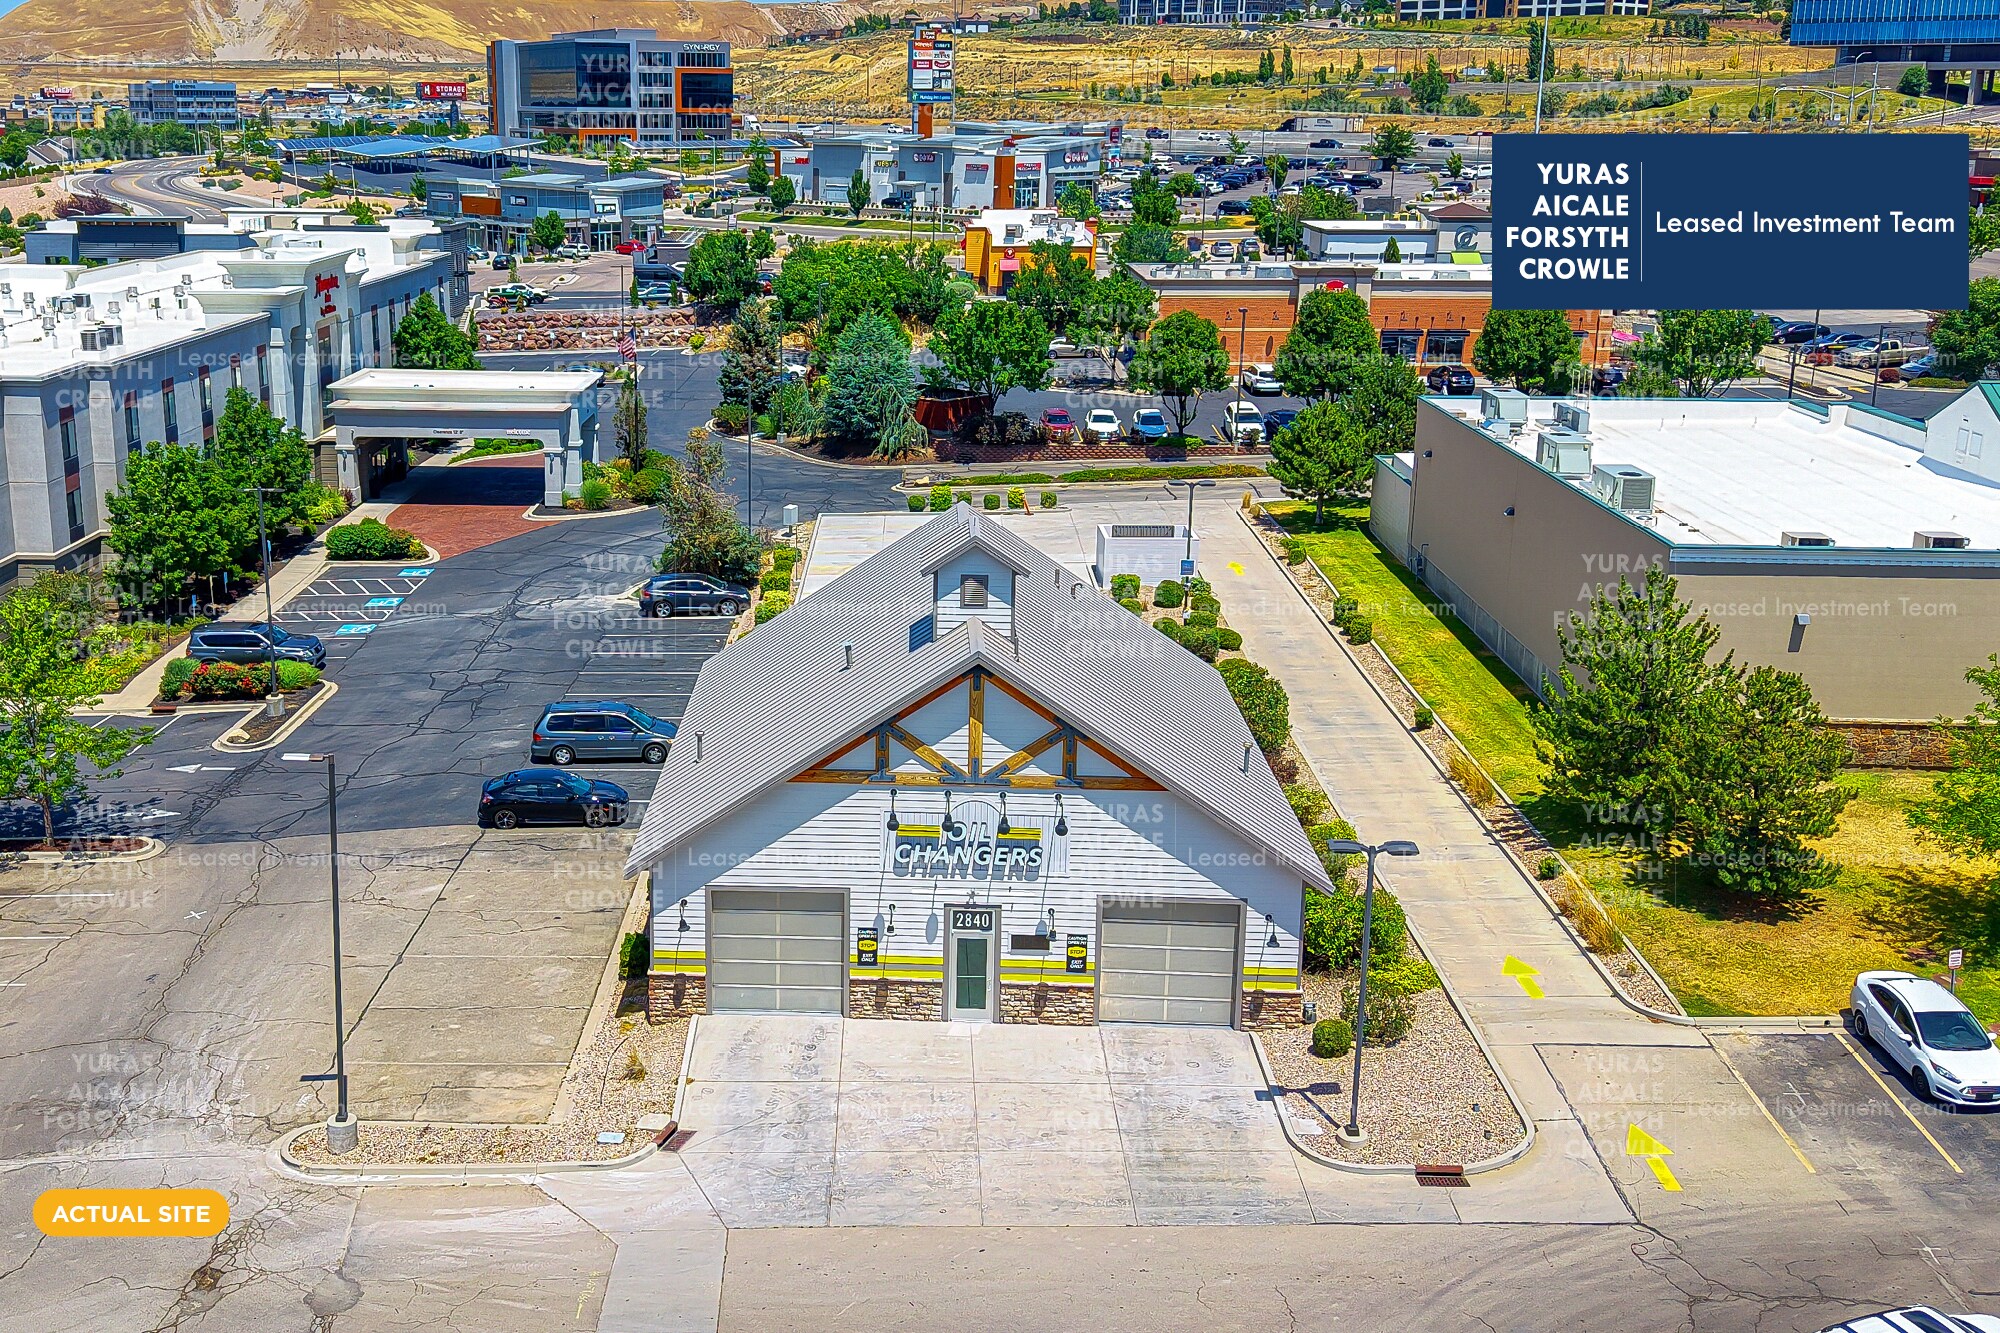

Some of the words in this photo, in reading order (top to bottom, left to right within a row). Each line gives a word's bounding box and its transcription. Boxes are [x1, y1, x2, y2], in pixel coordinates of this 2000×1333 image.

[435, 85, 466, 93] STORAGE
[947, 821, 991, 843] OIL
[894, 843, 1043, 867] CHANGERS
[956, 913, 990, 928] 2840
